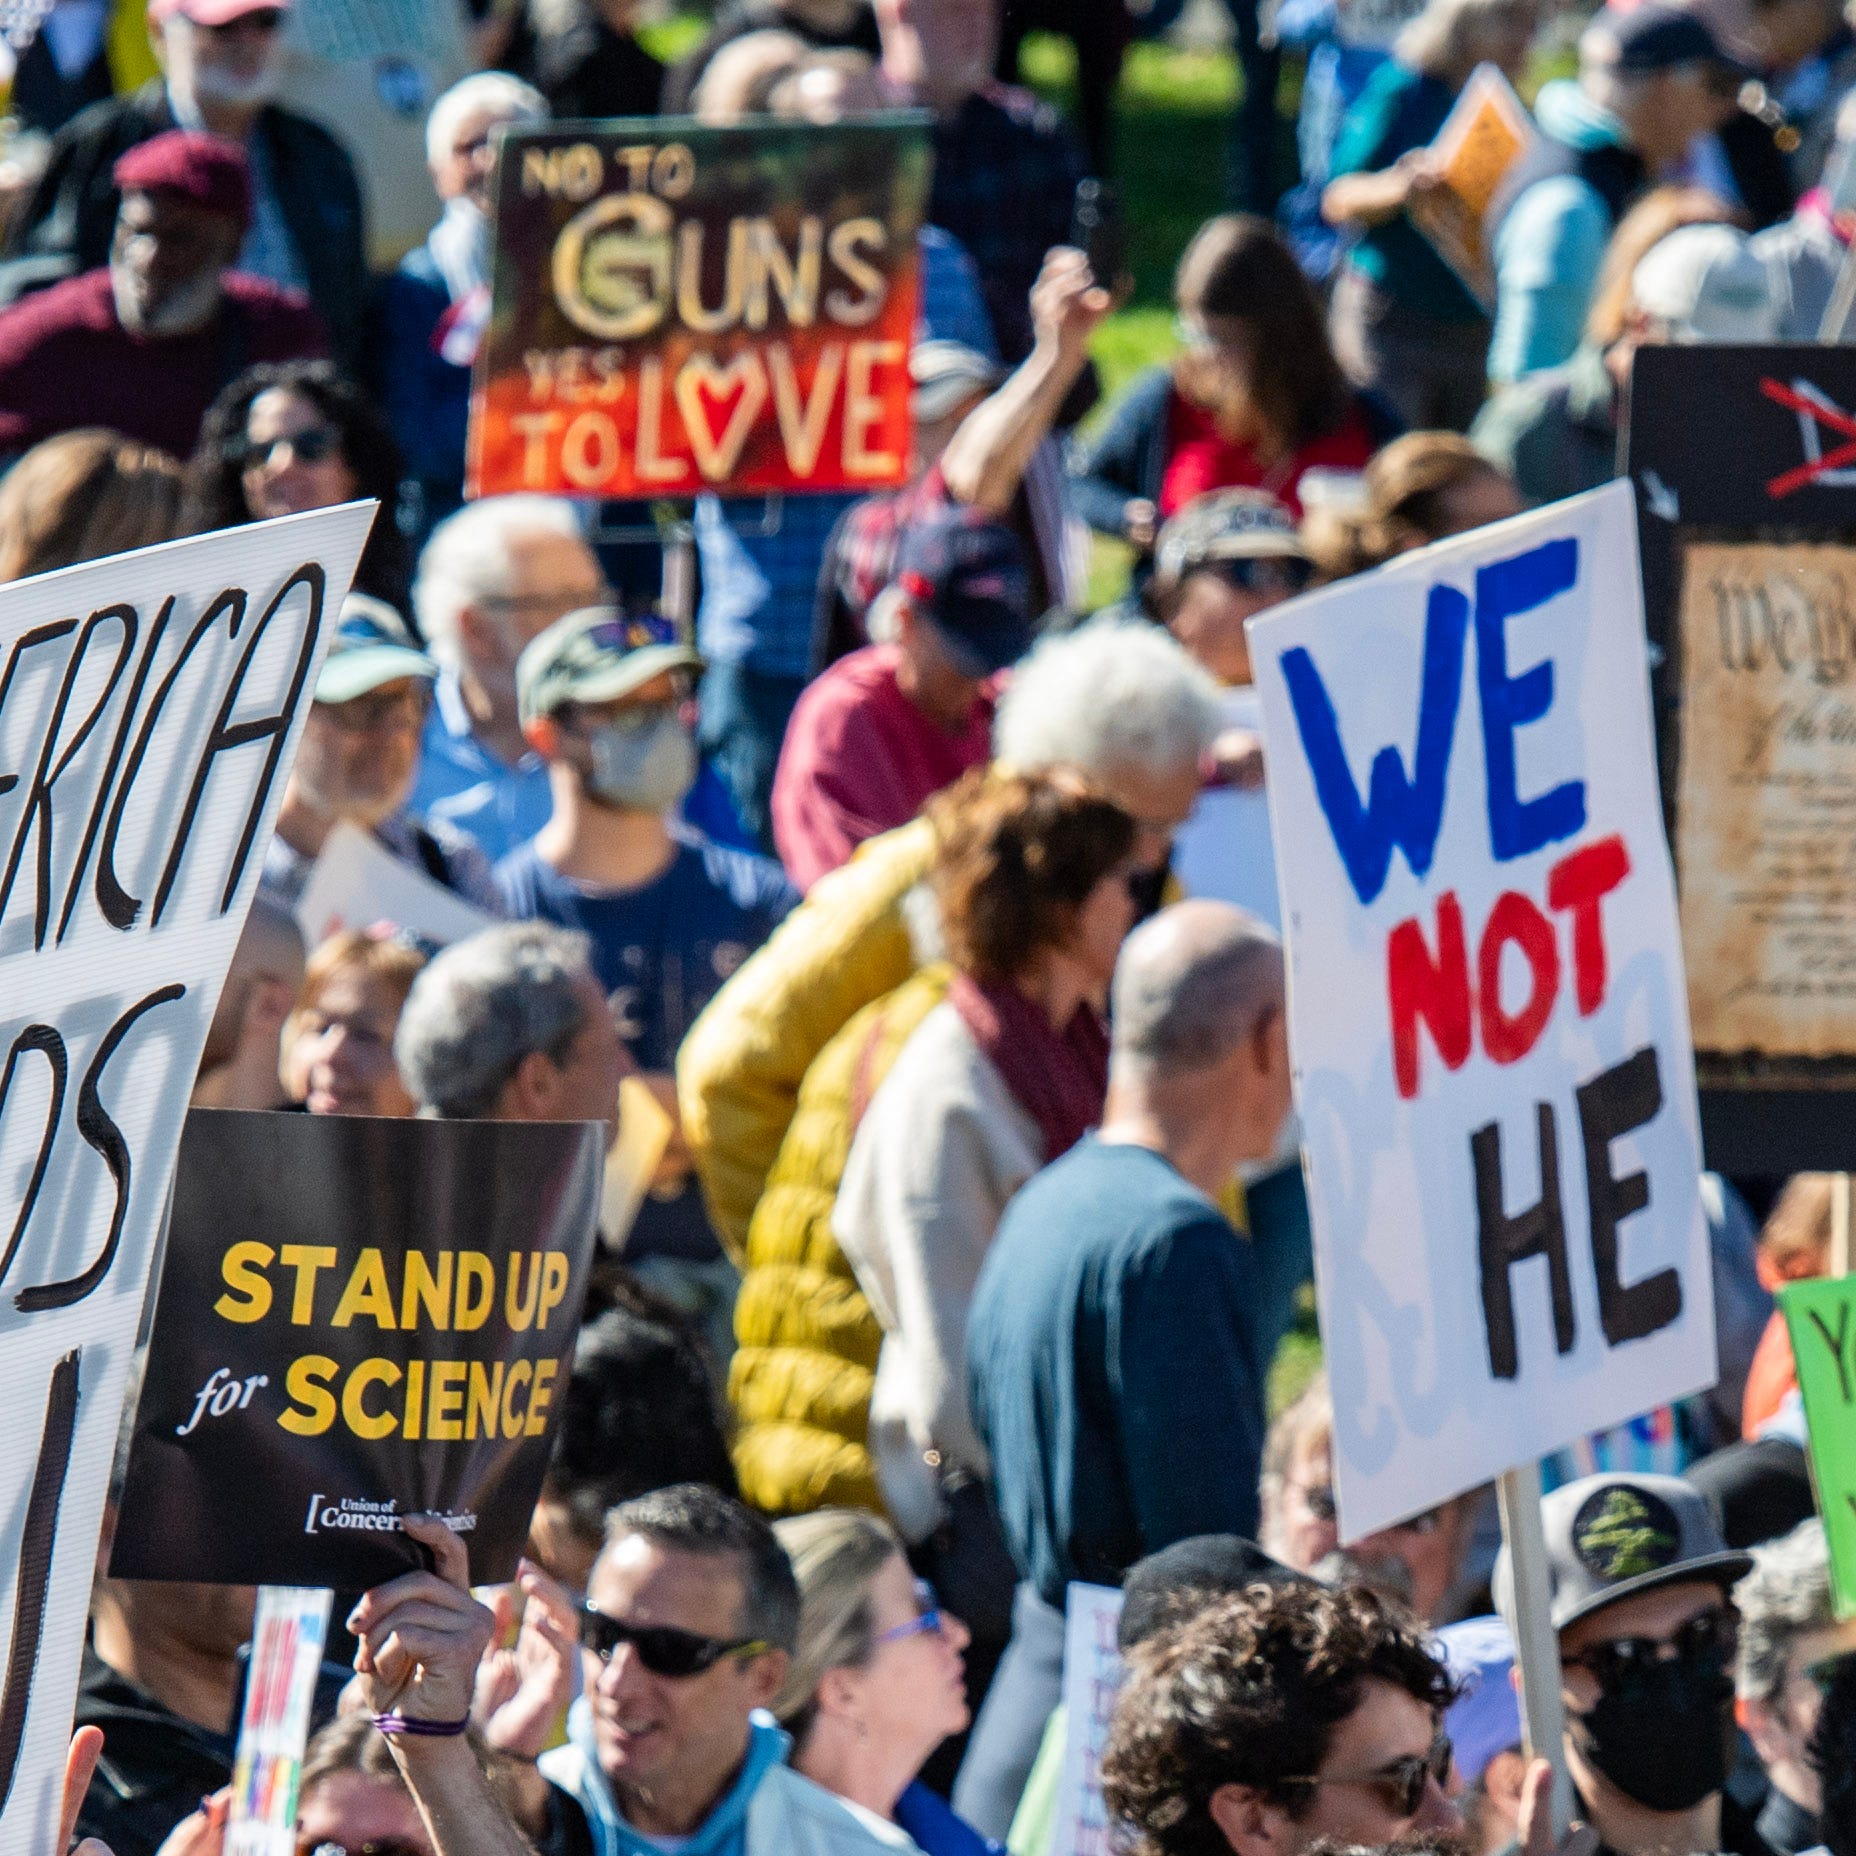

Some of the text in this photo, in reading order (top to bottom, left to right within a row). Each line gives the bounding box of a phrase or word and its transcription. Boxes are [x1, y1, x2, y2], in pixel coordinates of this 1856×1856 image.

[520, 144, 696, 200] NO TO
[552, 193, 890, 338] GUNS
[526, 350, 626, 402] YES
[512, 412, 620, 488] TO
[1278, 536, 1588, 906] WE
[1386, 834, 1633, 1100] NOT
[1468, 1045, 1684, 1381] HE
[213, 1240, 570, 1332] STAND UP
[175, 1354, 558, 1441] for SCIENCE
[340, 1497, 397, 1513] Union of
